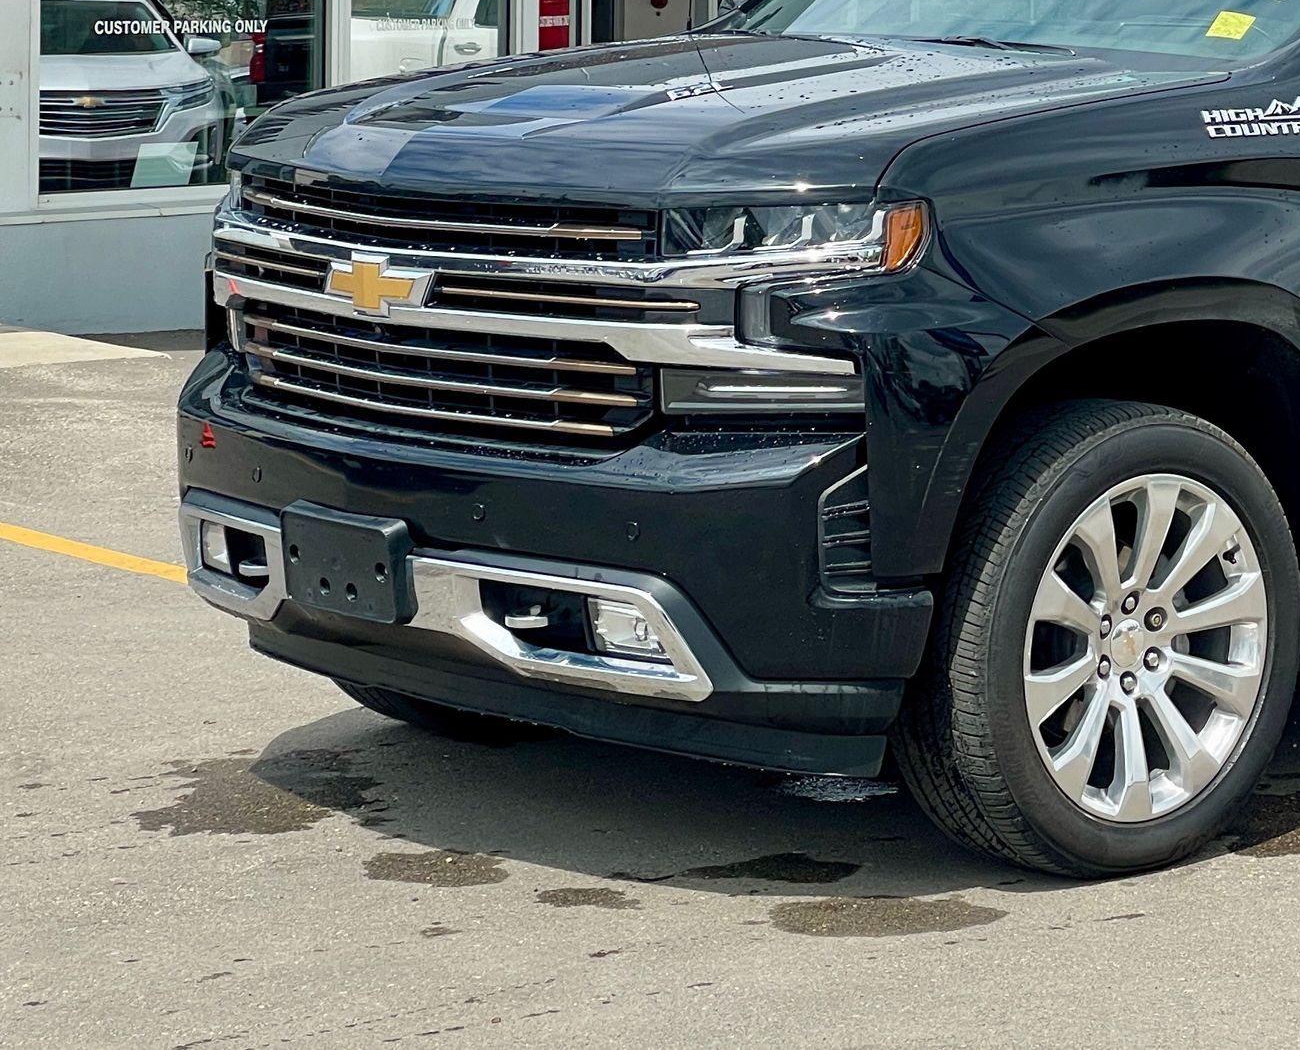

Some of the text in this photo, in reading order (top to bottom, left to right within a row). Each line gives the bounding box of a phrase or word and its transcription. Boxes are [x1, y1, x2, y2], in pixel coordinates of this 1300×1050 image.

[94, 19, 268, 35] CUSTOMER PARKING ONLY
[1201, 108, 1264, 124] HIGH
